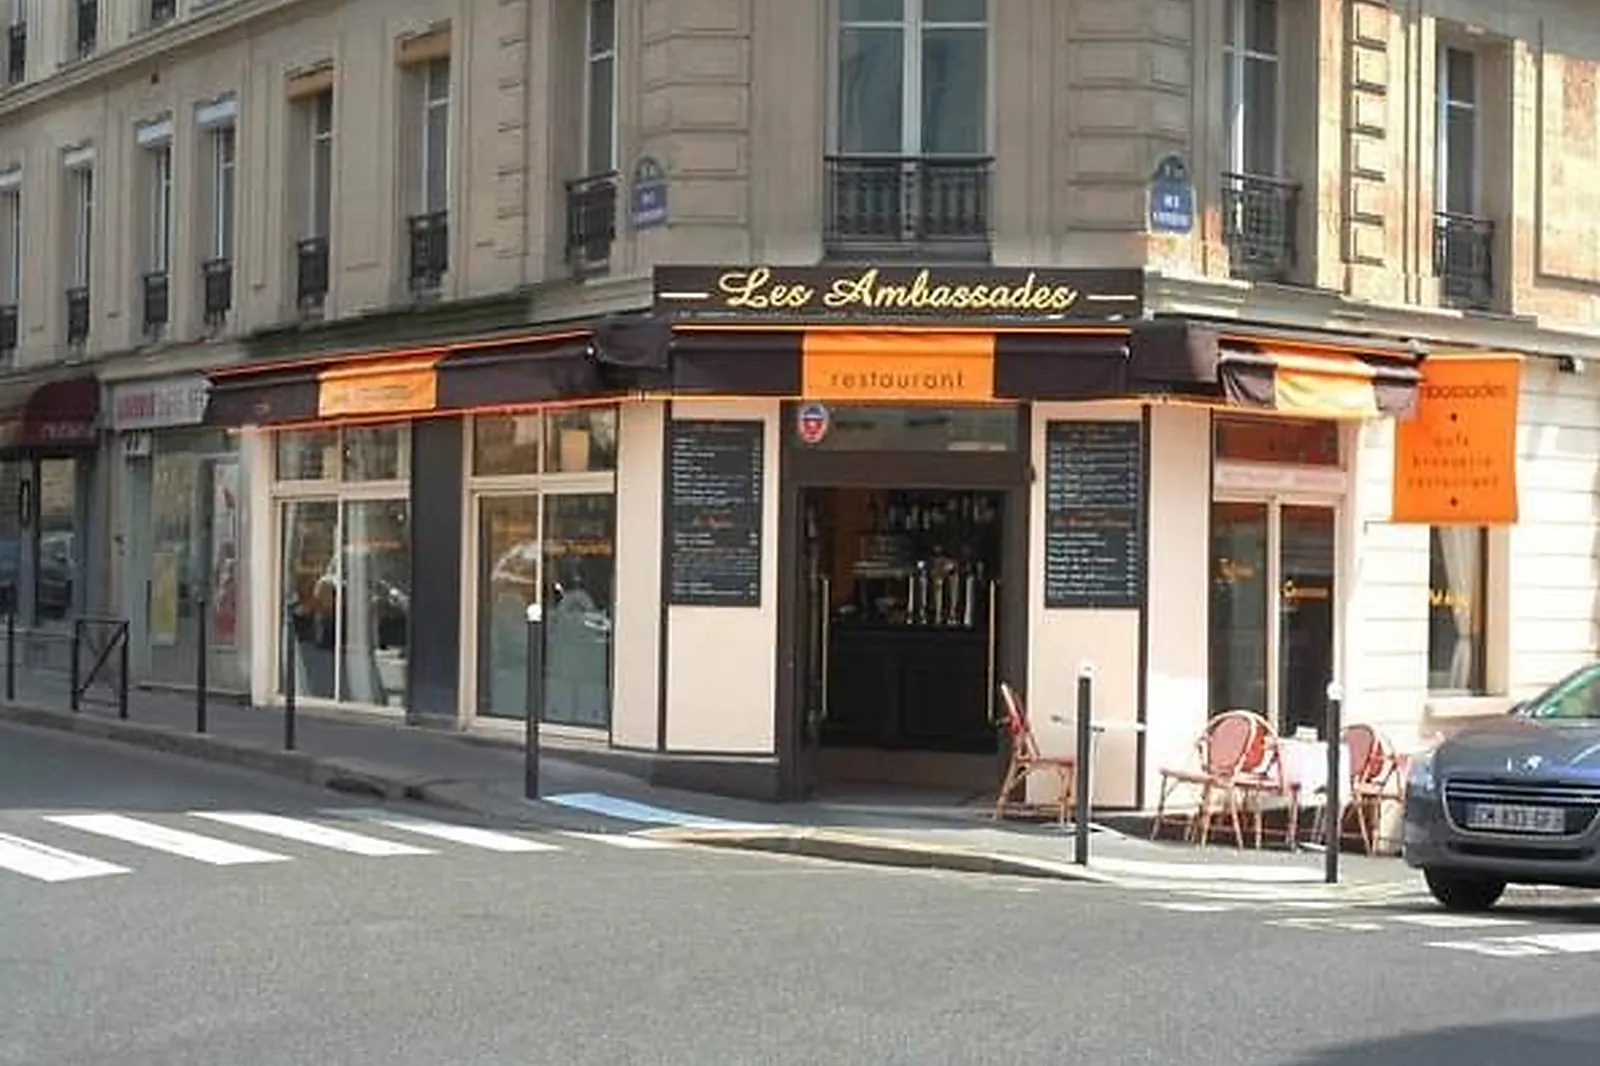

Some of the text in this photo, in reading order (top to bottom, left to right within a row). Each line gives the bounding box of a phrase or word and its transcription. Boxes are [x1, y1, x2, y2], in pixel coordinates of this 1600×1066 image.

[718, 267, 1078, 308] Les Ambassades
[831, 371, 964, 389] restaurant
